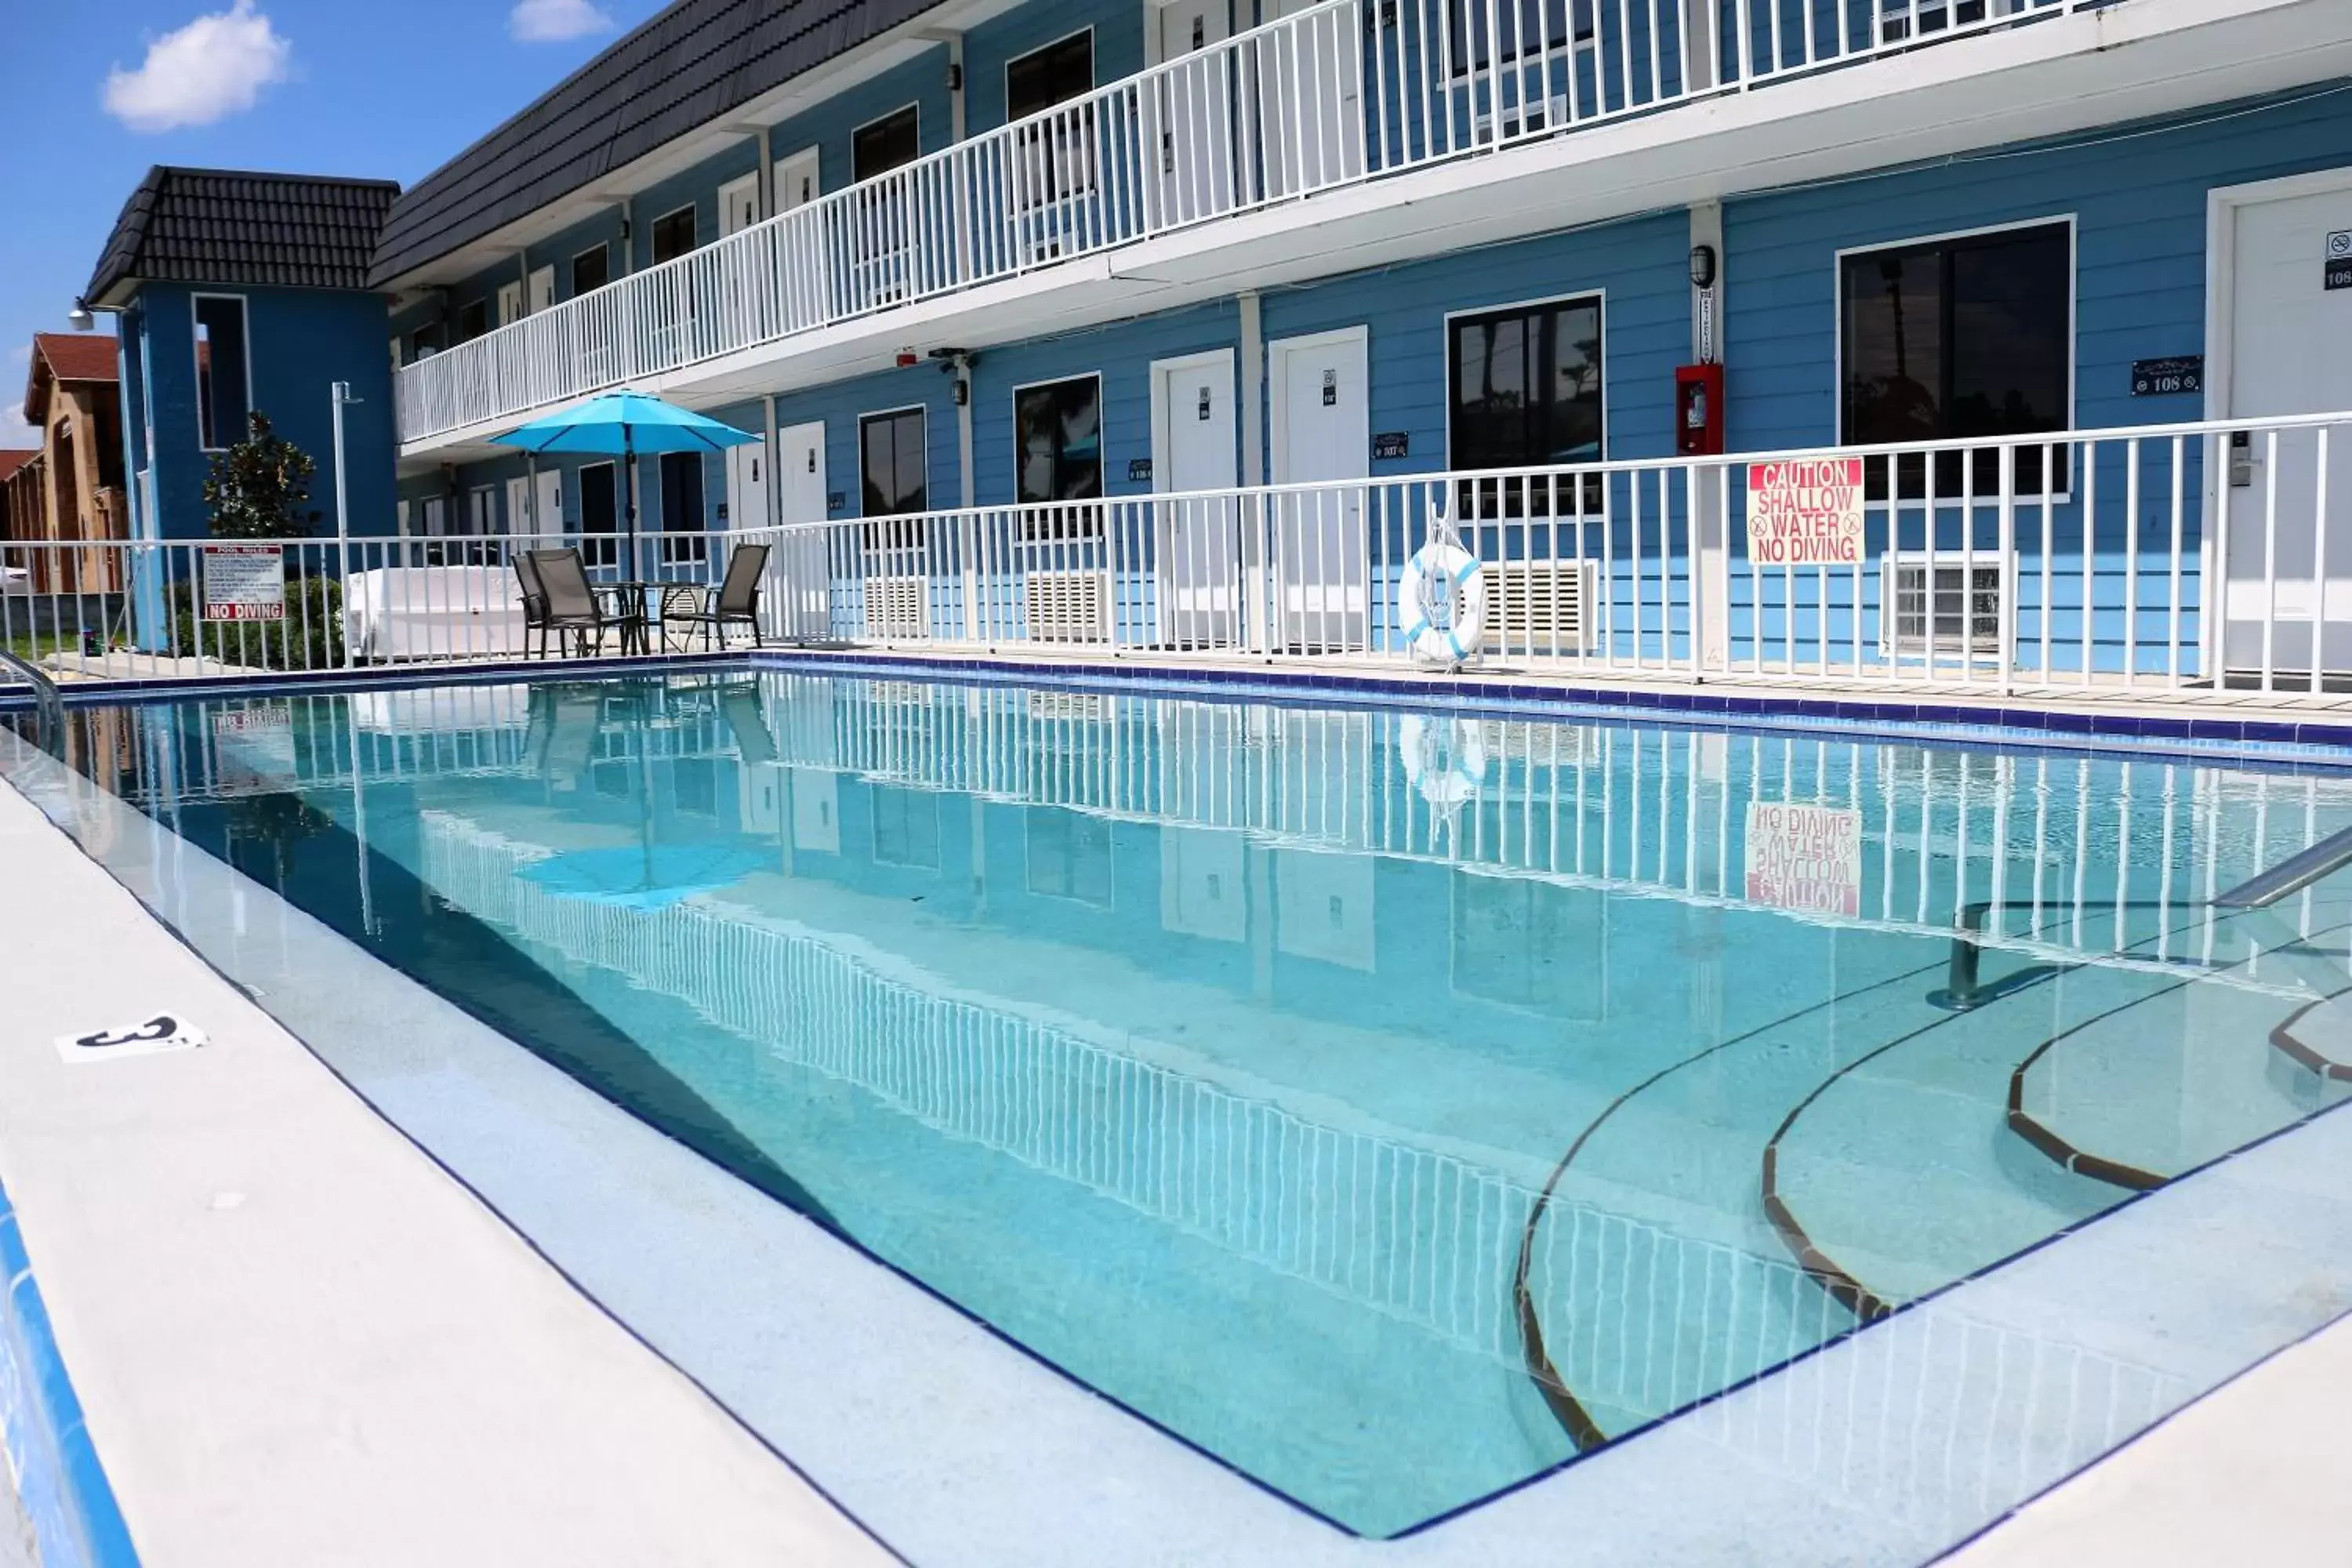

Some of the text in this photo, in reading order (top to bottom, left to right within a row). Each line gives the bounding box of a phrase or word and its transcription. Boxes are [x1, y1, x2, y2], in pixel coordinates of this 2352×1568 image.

[2155, 376, 2180, 391] 108
[1762, 459, 1849, 489] CAUTION
[1759, 487, 1853, 515] SHALLOW
[1770, 512, 1839, 537] WATER
[1758, 536, 1857, 562] NO DIVING
[209, 603, 281, 618] NO DIVING
[75, 1015, 178, 1047] 3
